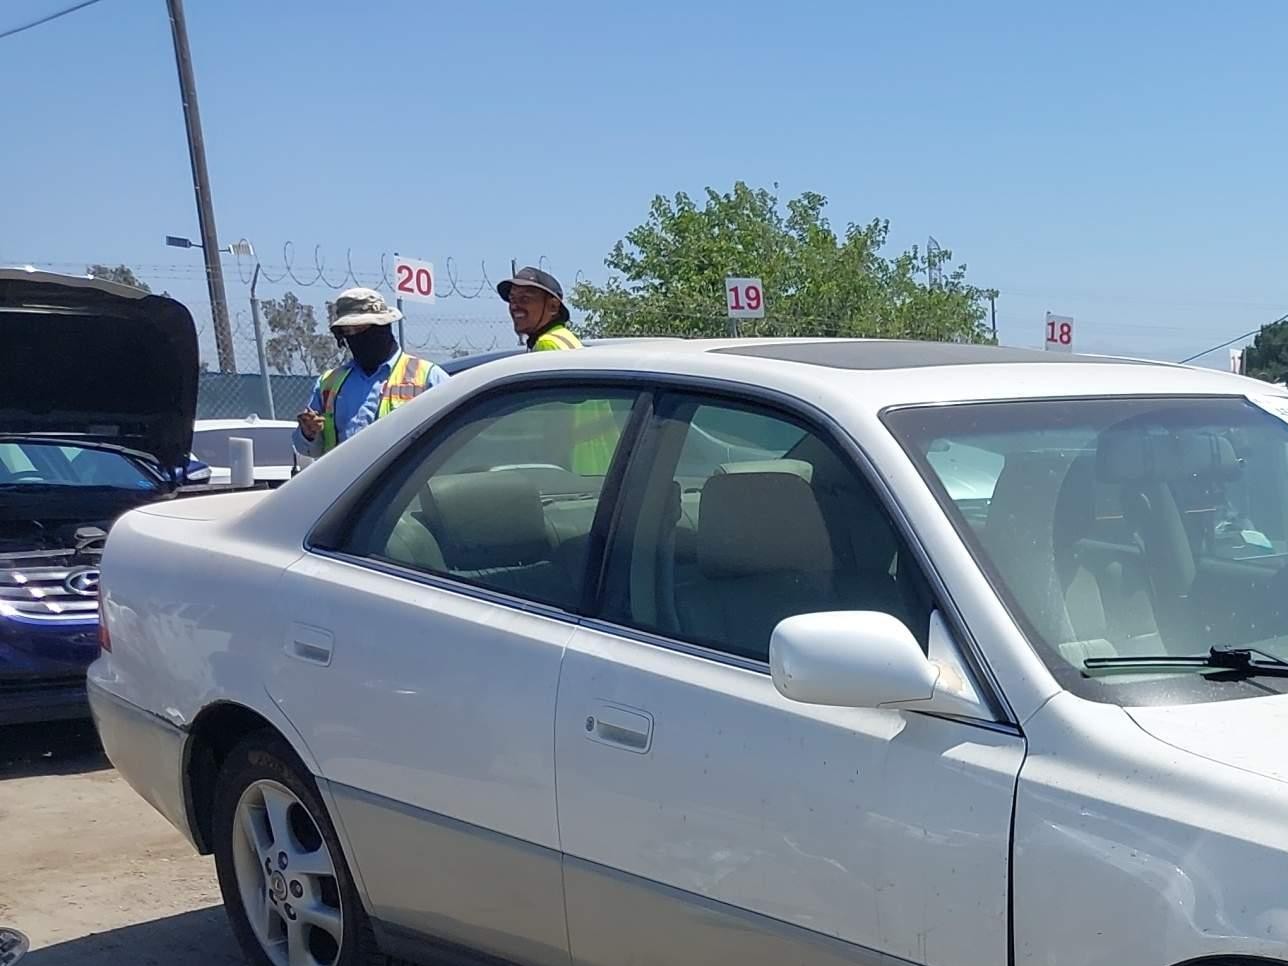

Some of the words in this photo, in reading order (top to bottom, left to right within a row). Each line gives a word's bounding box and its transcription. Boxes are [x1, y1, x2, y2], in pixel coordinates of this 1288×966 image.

[397, 265, 432, 296] 20
[729, 285, 761, 310] 19
[1047, 321, 1072, 345] 18
